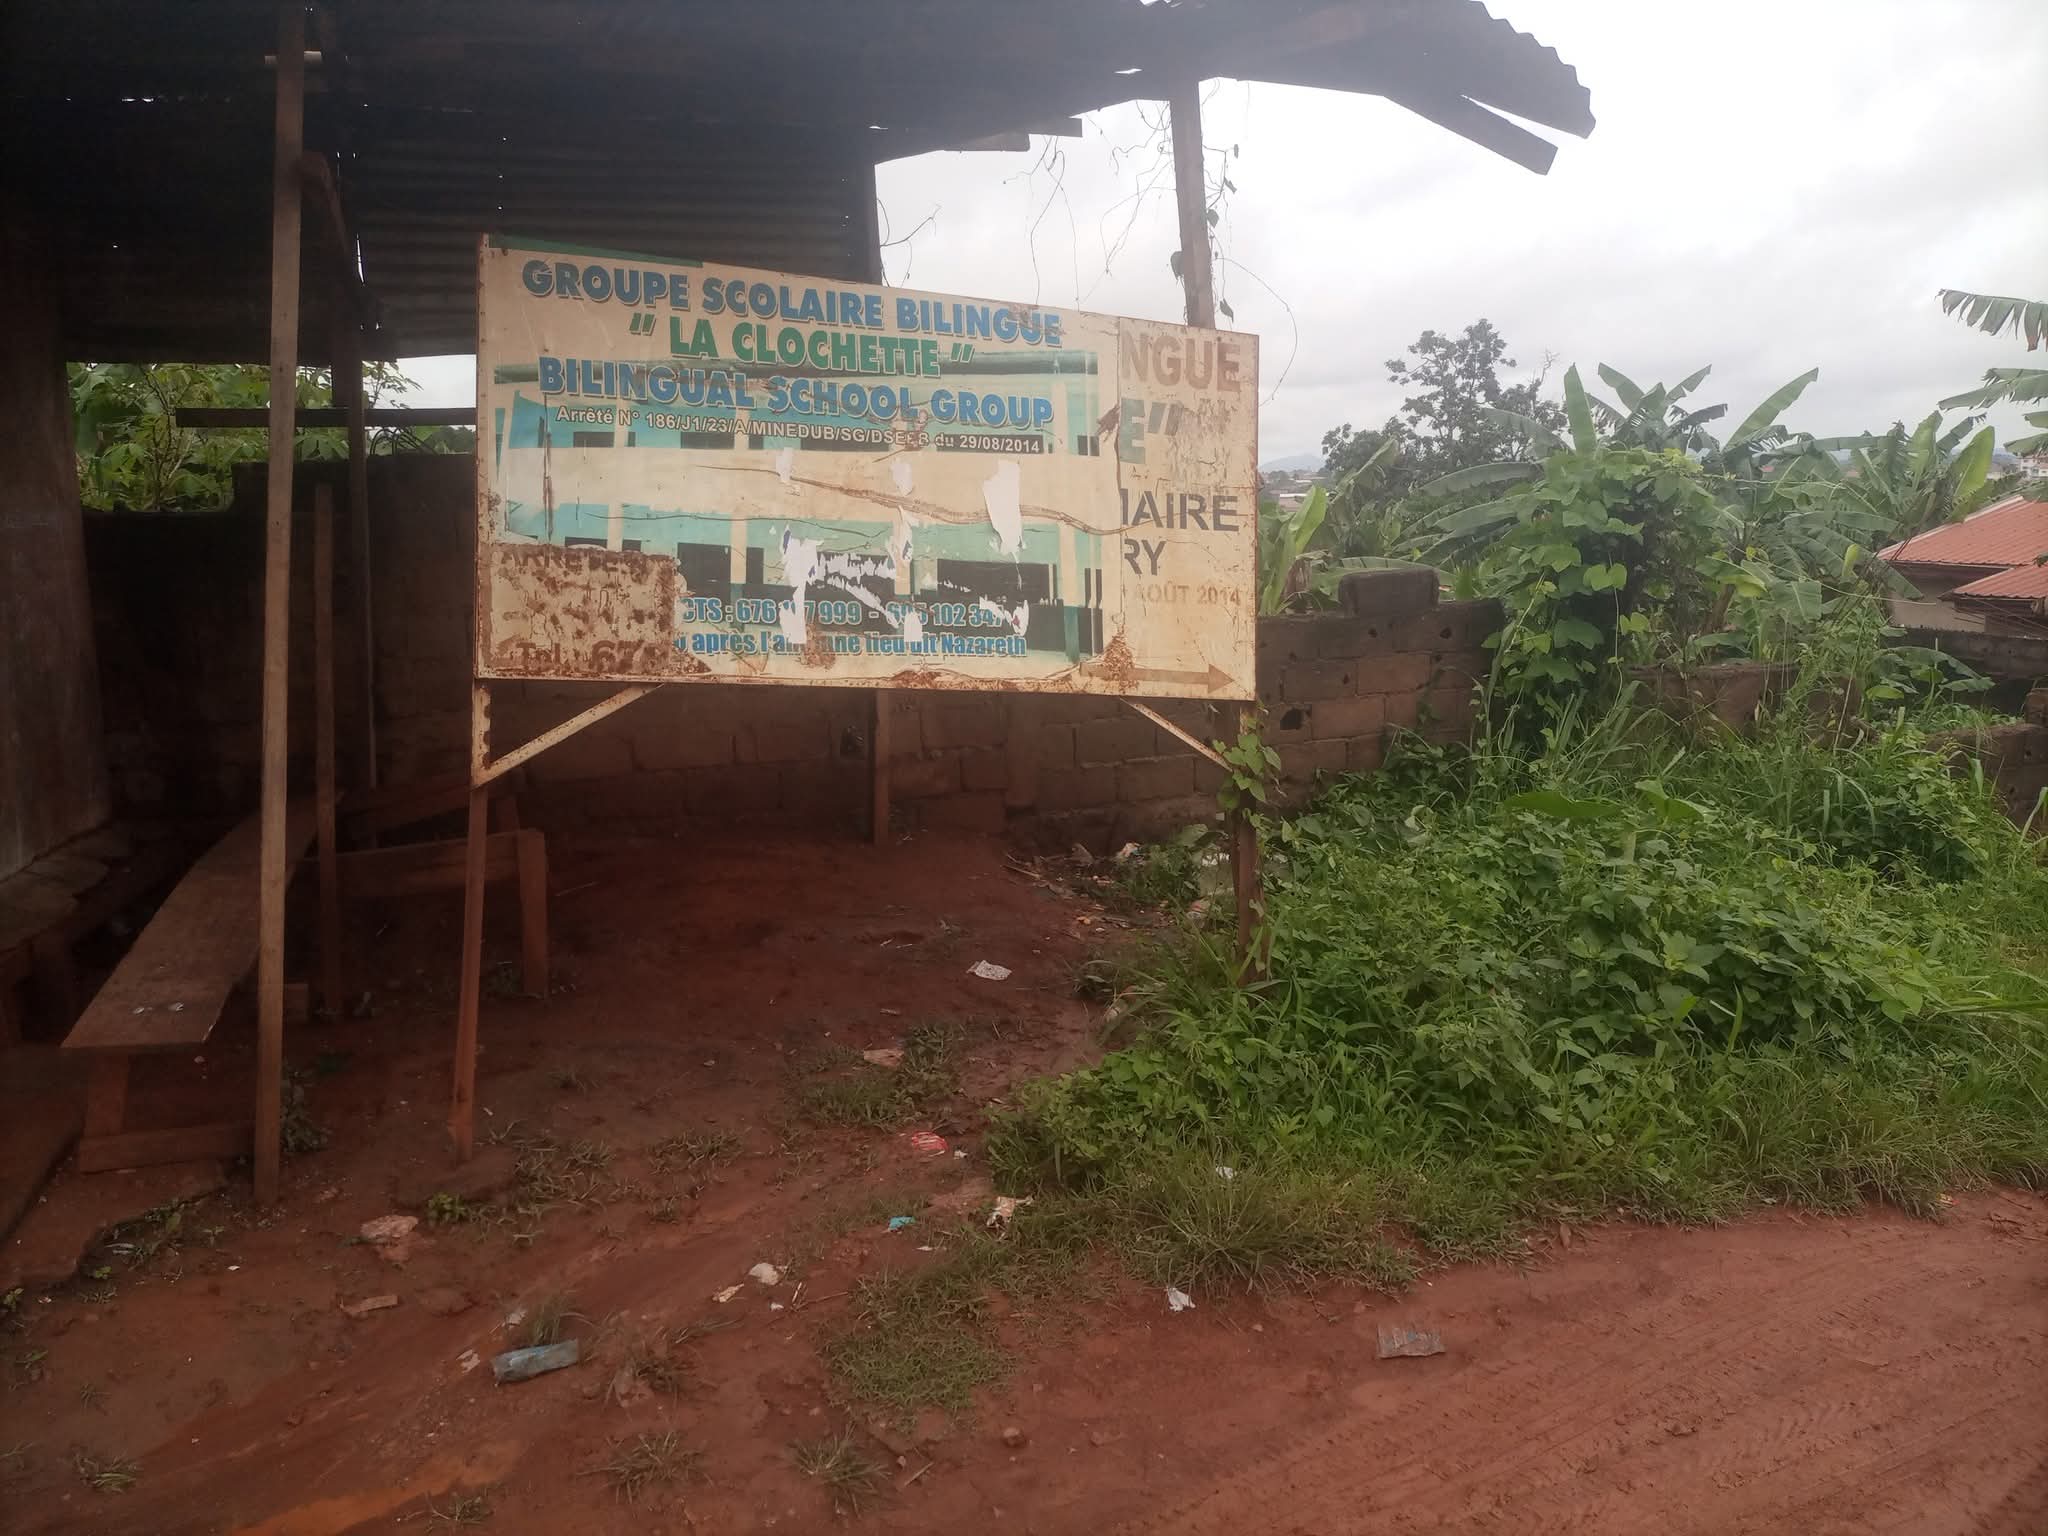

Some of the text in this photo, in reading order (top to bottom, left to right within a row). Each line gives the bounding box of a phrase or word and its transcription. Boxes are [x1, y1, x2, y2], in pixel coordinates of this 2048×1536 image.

[522, 260, 1063, 347] GROUPE SCOLAIRE BILINGUE
[731, 322, 941, 378] CLOCHETTE
[539, 356, 1054, 431] BILINGUAL SCHOOL GROUP
[556, 405, 614, 425] Arrêté
[935, 432, 954, 448] du
[959, 434, 1041, 454] 29/08/2014
[736, 598, 776, 624] 676
[818, 600, 862, 626] 999
[931, 602, 966, 627] 102
[692, 631, 756, 656] après
[940, 632, 1028, 656] Nazareth
